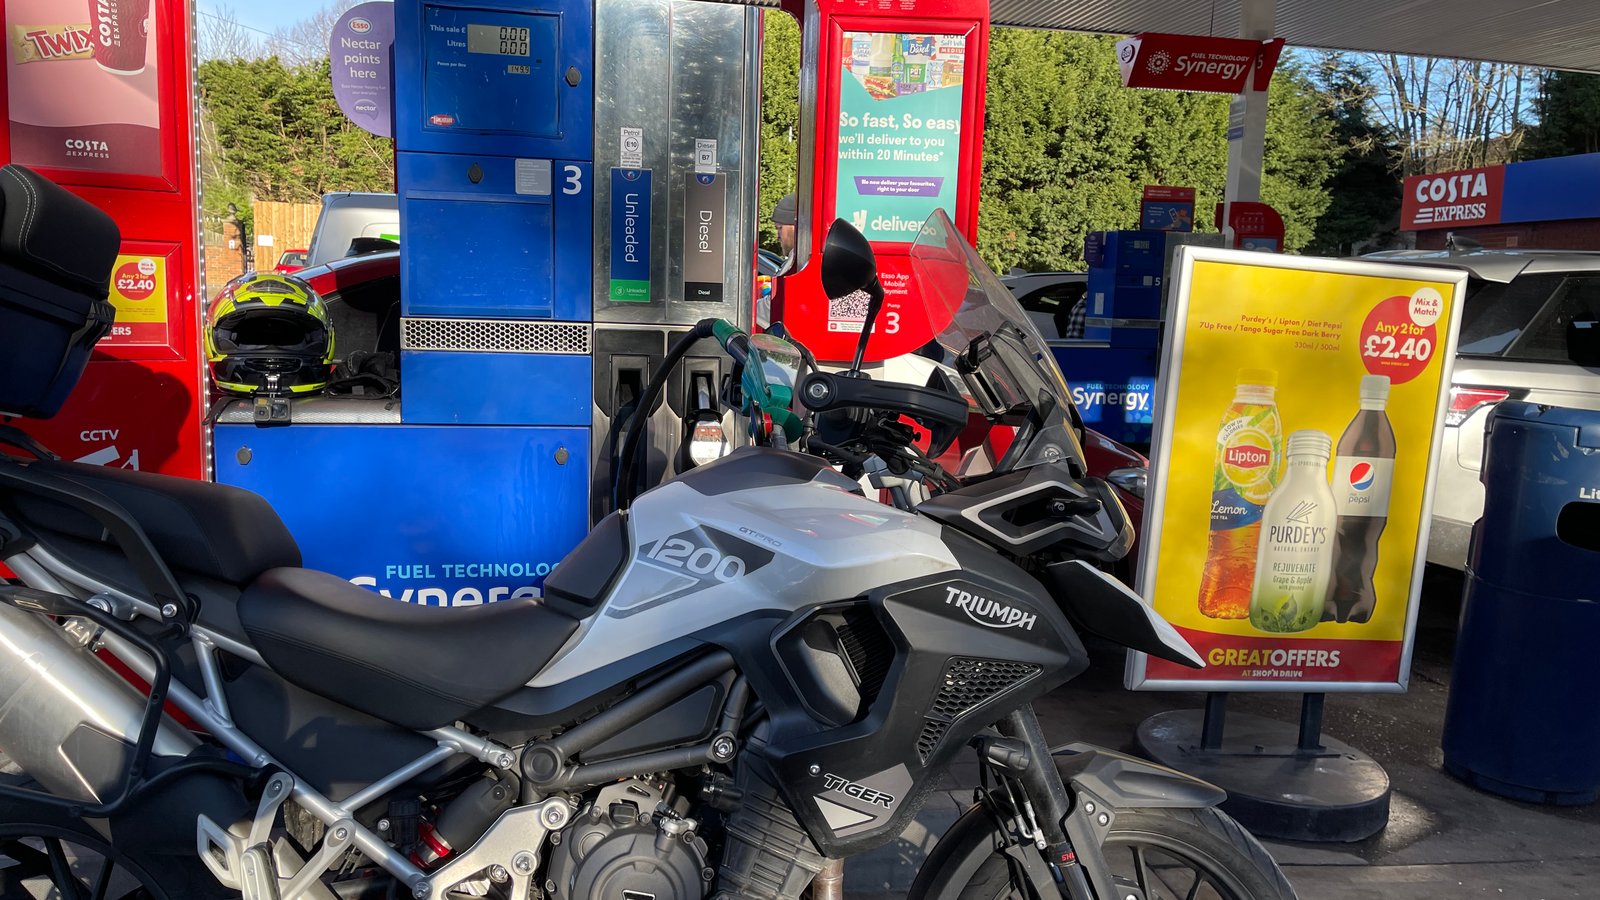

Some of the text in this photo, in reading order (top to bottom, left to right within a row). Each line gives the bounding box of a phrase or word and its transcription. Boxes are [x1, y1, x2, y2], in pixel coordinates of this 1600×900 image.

[111, 0, 120, 39] EXPRES
[352, 21, 368, 30] Esso
[430, 24, 466, 34] This sale £
[341, 37, 381, 50] Nectar
[447, 39, 466, 48] Litres
[344, 53, 381, 65] points
[1208, 53, 1250, 62] TECHNOLOGY
[1256, 54, 1263, 69] 5
[350, 67, 377, 79] here
[1174, 56, 1246, 80] Synergy
[840, 112, 961, 135] So fast, So easy
[65, 138, 109, 151] COSTA
[839, 133, 945, 149] we'll deliver to you
[72, 150, 109, 158] EXPRESS
[838, 149, 874, 160] within
[877, 149, 890, 160] 20
[562, 165, 582, 195] 3
[1416, 172, 1488, 203] COSTA
[1434, 202, 1486, 222] EXPRESS
[625, 193, 639, 263] Unleaded
[698, 210, 713, 253] Diesel
[896, 272, 910, 281] App
[1155, 277, 1161, 286] 5
[117, 279, 154, 290] £2.40
[1415, 298, 1438, 307] Mix &
[1413, 307, 1437, 316] Match
[885, 311, 900, 334] 3
[1241, 314, 1272, 324] Purdey's
[1280, 318, 1300, 327] Lipton
[1307, 320, 1322, 328] Diet
[1323, 321, 1342, 330] Pepsi
[1375, 320, 1426, 336] Any 2 for
[1200, 321, 1215, 331] 7Up
[1216, 323, 1232, 331] Free
[1240, 324, 1262, 333] Tango
[1263, 326, 1283, 336] Sugar
[1285, 328, 1300, 336] Free
[1302, 329, 1319, 337] Dark
[1321, 331, 1342, 340] Berry
[1294, 341, 1314, 349] 330ml
[1319, 343, 1340, 351] 500ml
[1364, 334, 1432, 362] £2.40
[1072, 386, 1149, 411] Synergy
[80, 429, 119, 442] CCTV
[1229, 450, 1267, 463] Lipton
[1348, 495, 1370, 503] pepsi
[1211, 500, 1248, 515] Lemon
[1269, 525, 1327, 544] PURDEY'S
[646, 536, 746, 584] 1200
[386, 564, 436, 579] FUEL
[1272, 562, 1316, 573] REJUVENATE
[1272, 575, 1290, 584] Grape
[1296, 576, 1312, 585] Apple
[946, 586, 1037, 631] TRIUMPH
[1280, 670, 1303, 678] DRIVE
[824, 773, 895, 809] TIGER
